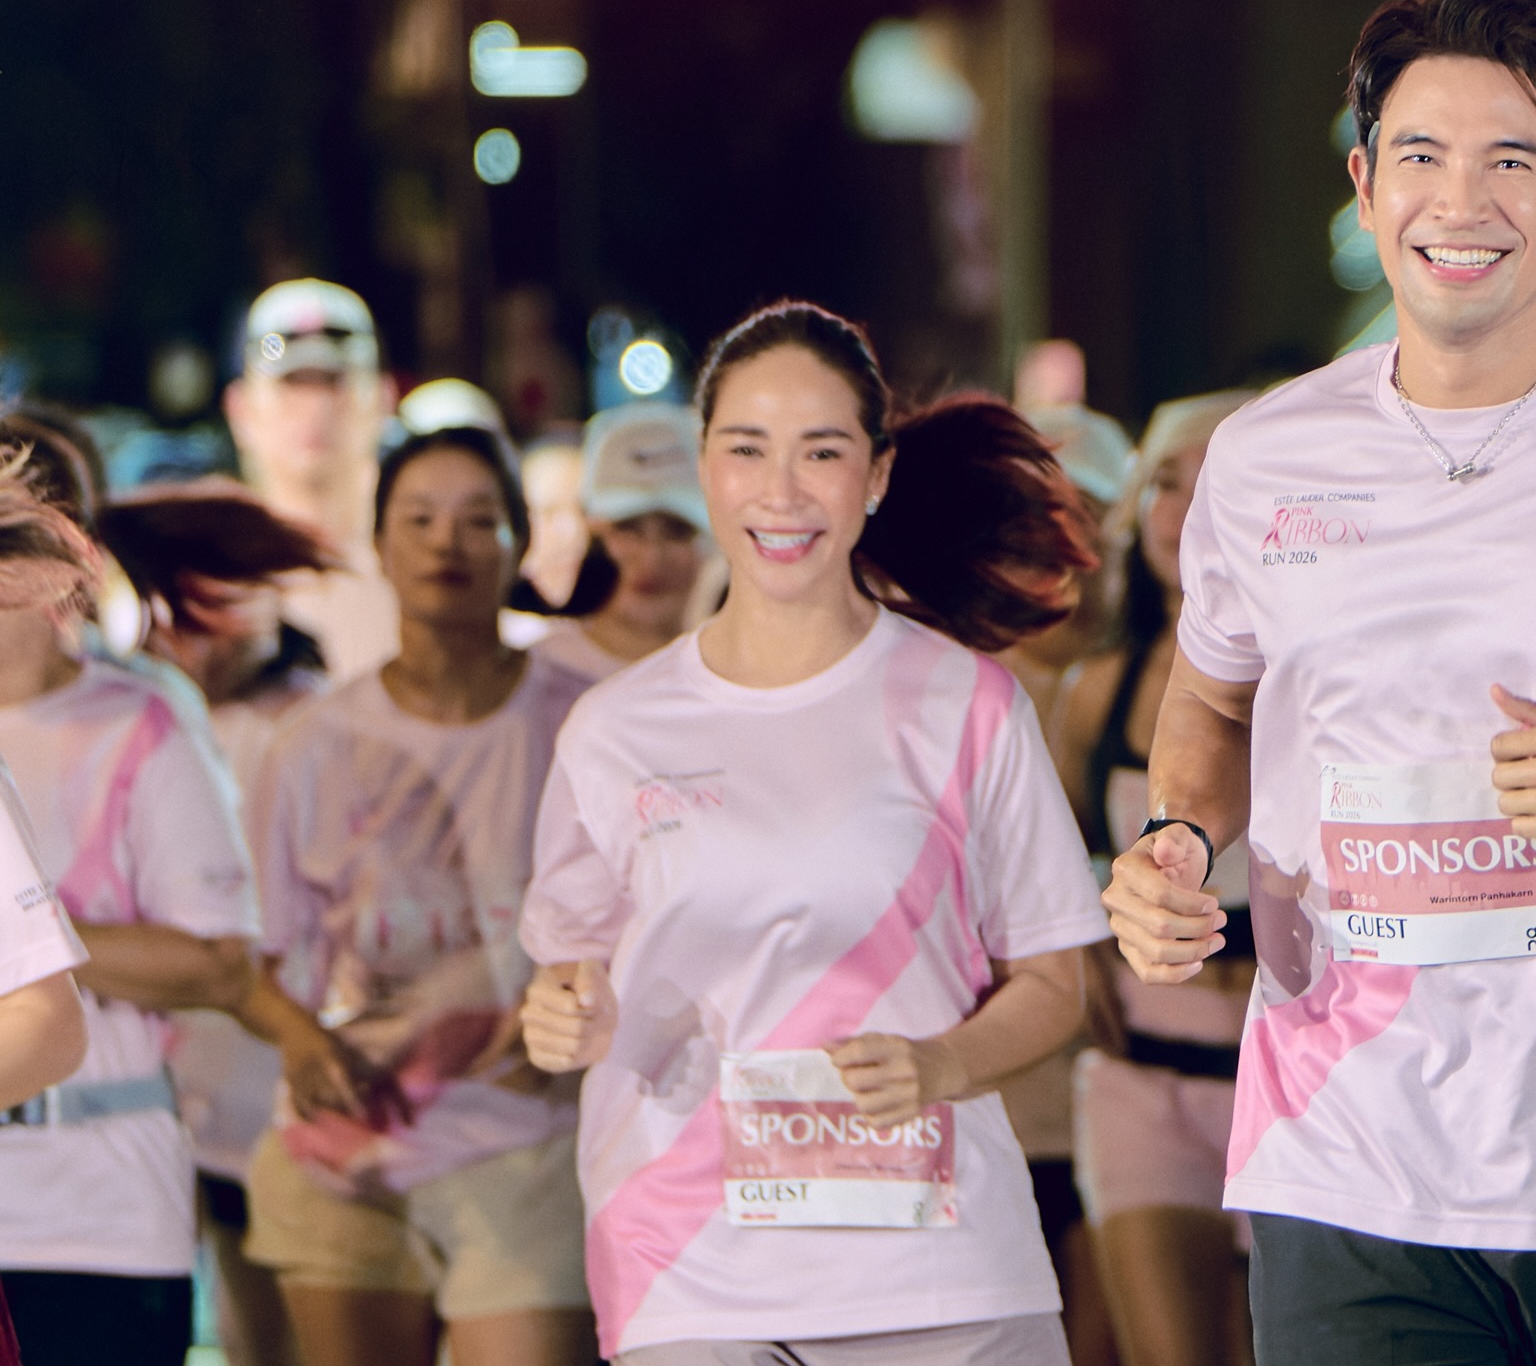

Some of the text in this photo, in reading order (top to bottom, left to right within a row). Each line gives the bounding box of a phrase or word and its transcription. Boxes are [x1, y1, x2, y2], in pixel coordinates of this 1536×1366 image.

[1274, 493, 1376, 506] ESTÉE LAUDER COMPANIES
[1291, 507, 1314, 517] PINK
[1260, 508, 1373, 552] RIBBON
[1262, 551, 1318, 567] RUN 2026
[1430, 895, 1479, 905] Warintorn
[1347, 914, 1408, 939] GUEST
[740, 1112, 943, 1150] SPONSORS
[739, 1183, 811, 1203] GUEST
